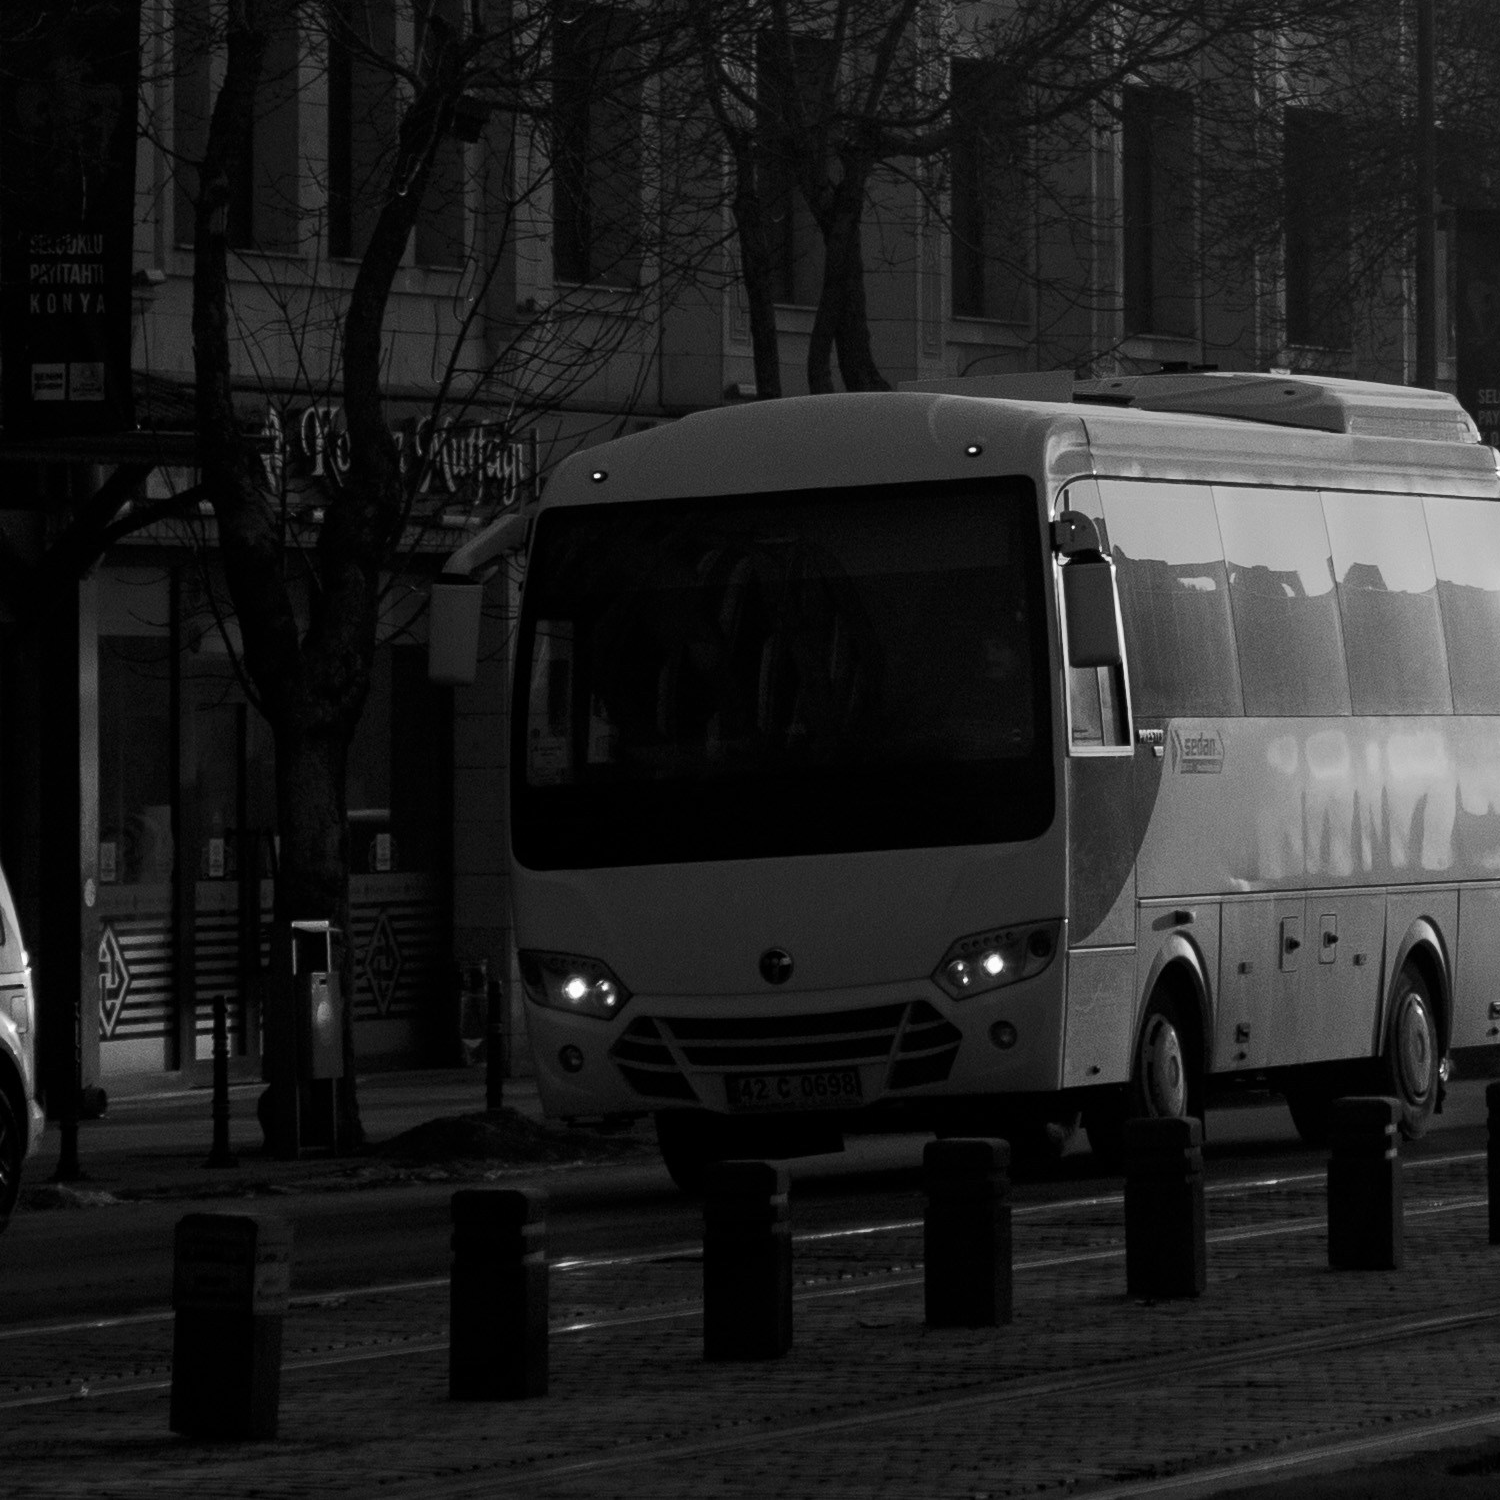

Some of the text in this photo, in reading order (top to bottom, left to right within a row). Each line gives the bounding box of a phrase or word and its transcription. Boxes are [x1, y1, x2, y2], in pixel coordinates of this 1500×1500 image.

[30, 293, 105, 314] KONYA
[1184, 732, 1216, 756] sedan
[741, 1073, 855, 1100] 42 C 0698
